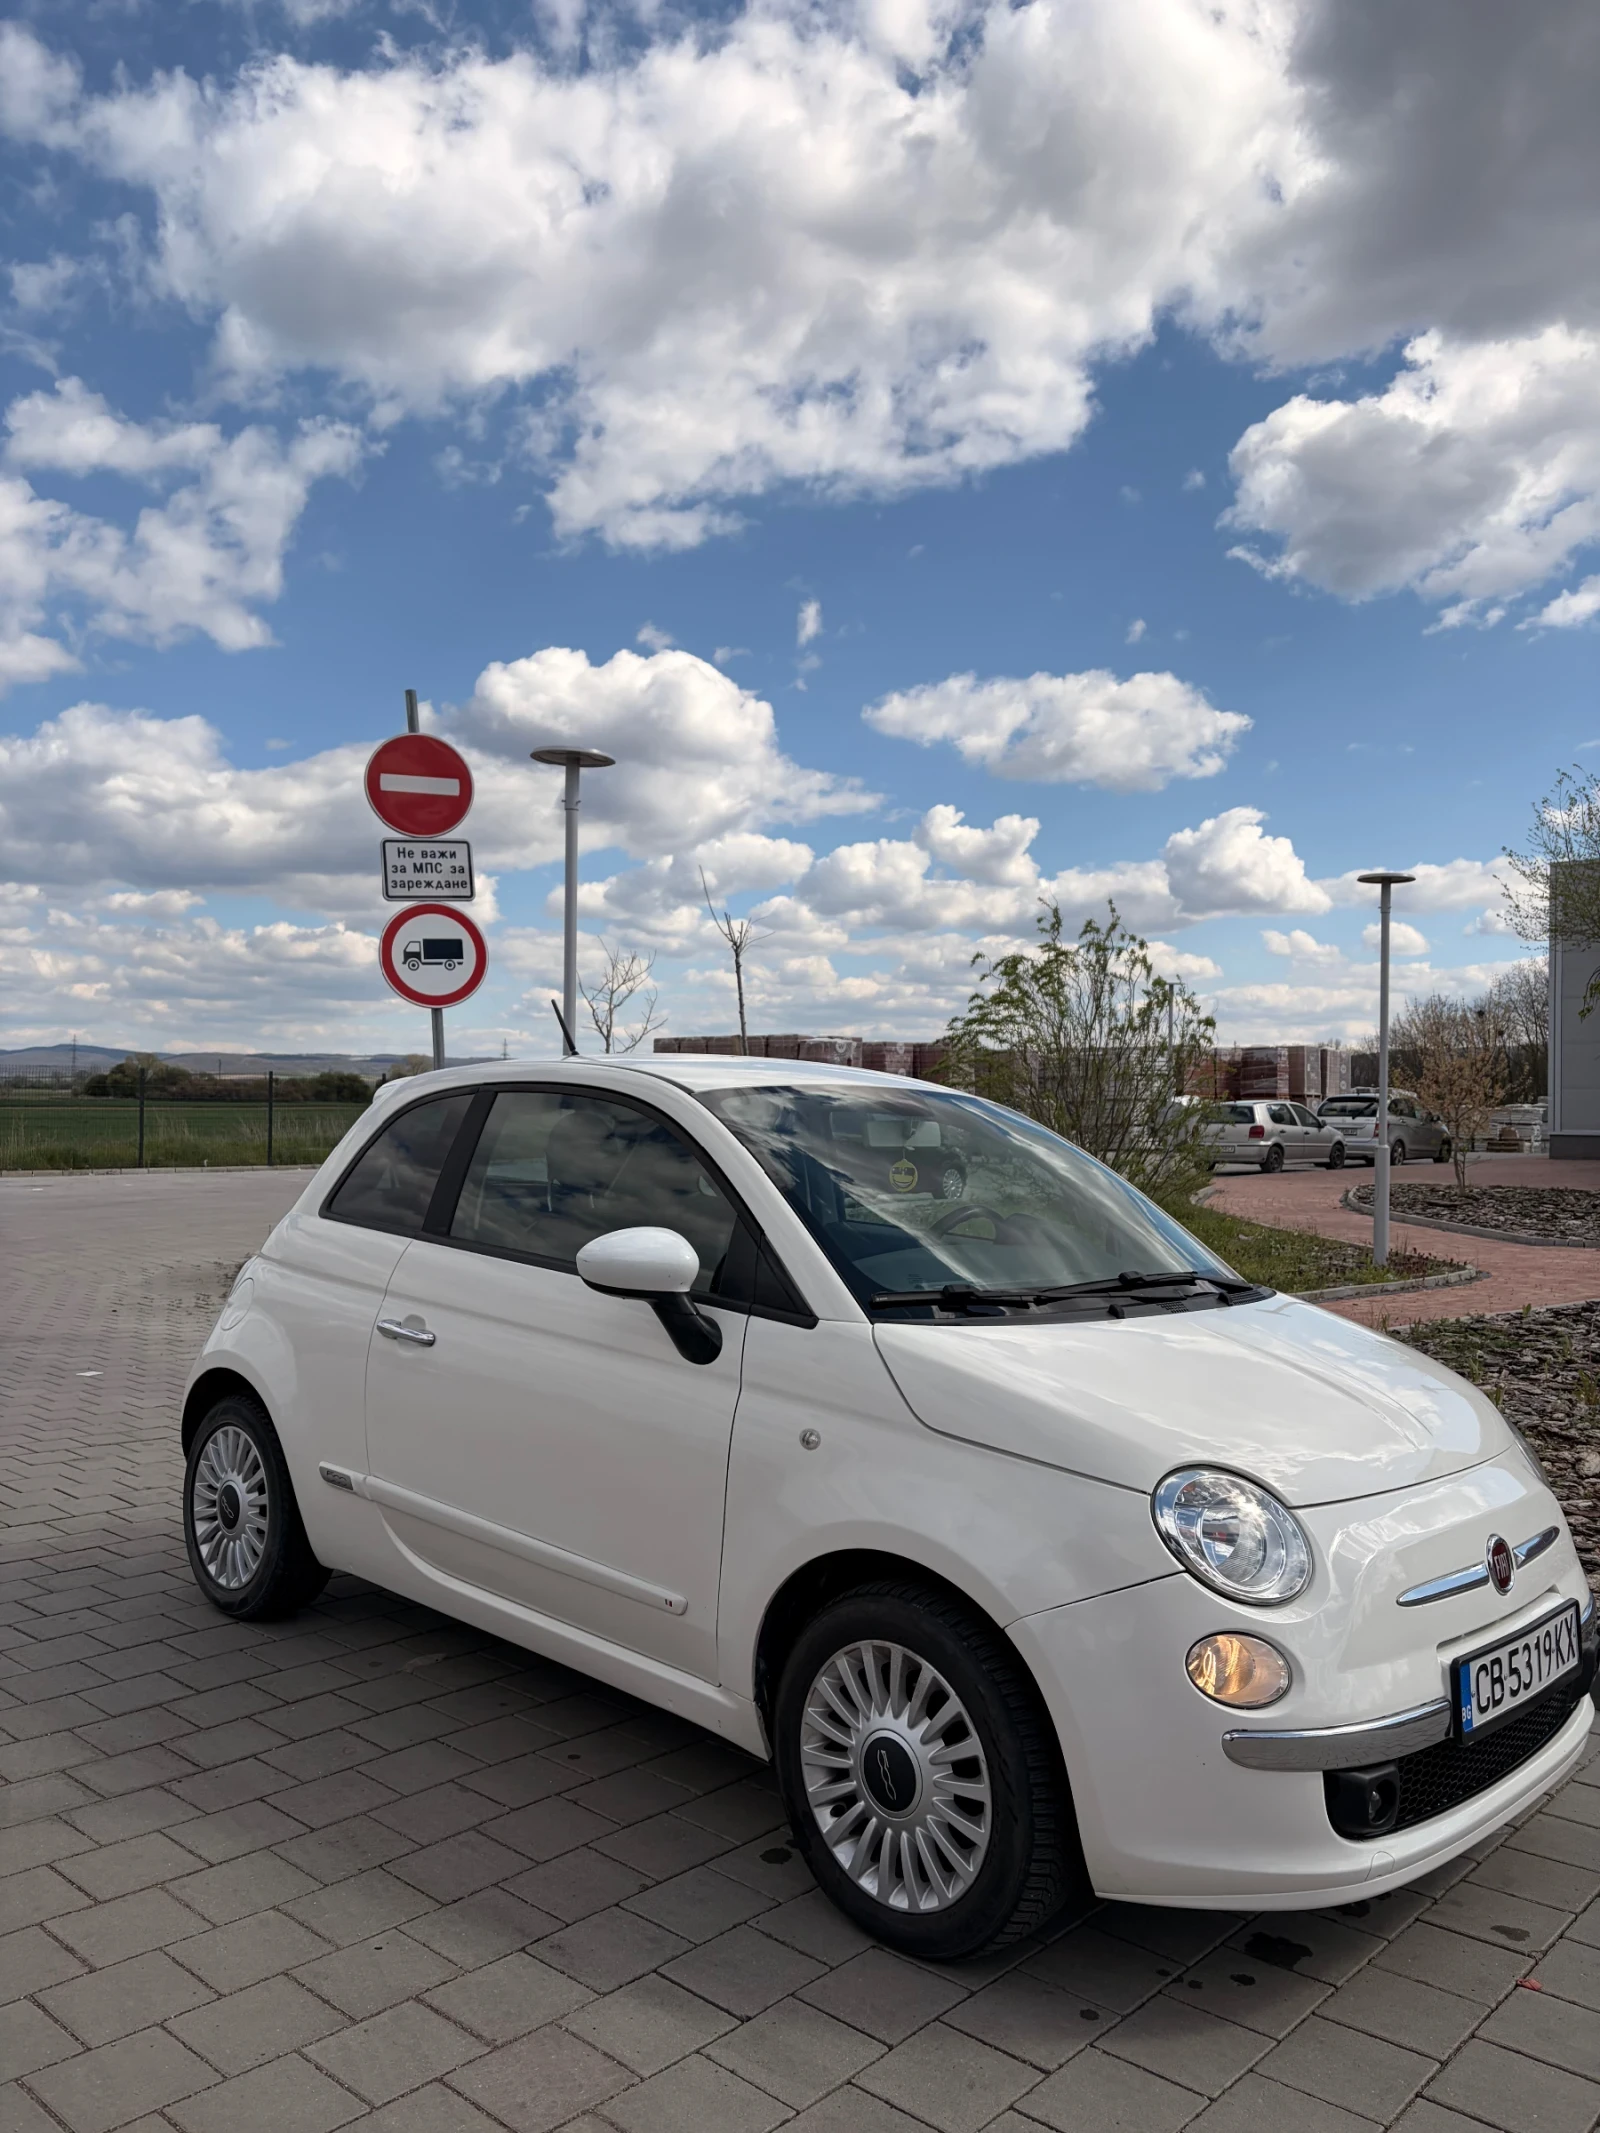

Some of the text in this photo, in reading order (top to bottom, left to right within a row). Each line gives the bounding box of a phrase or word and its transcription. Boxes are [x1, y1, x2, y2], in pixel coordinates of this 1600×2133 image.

[397, 847, 457, 859] Не важи
[391, 862, 465, 874] за МПС за
[391, 879, 468, 892] зареждане
[1493, 1552, 1510, 1580] FIAT
[1461, 1705, 1472, 1723] BG
